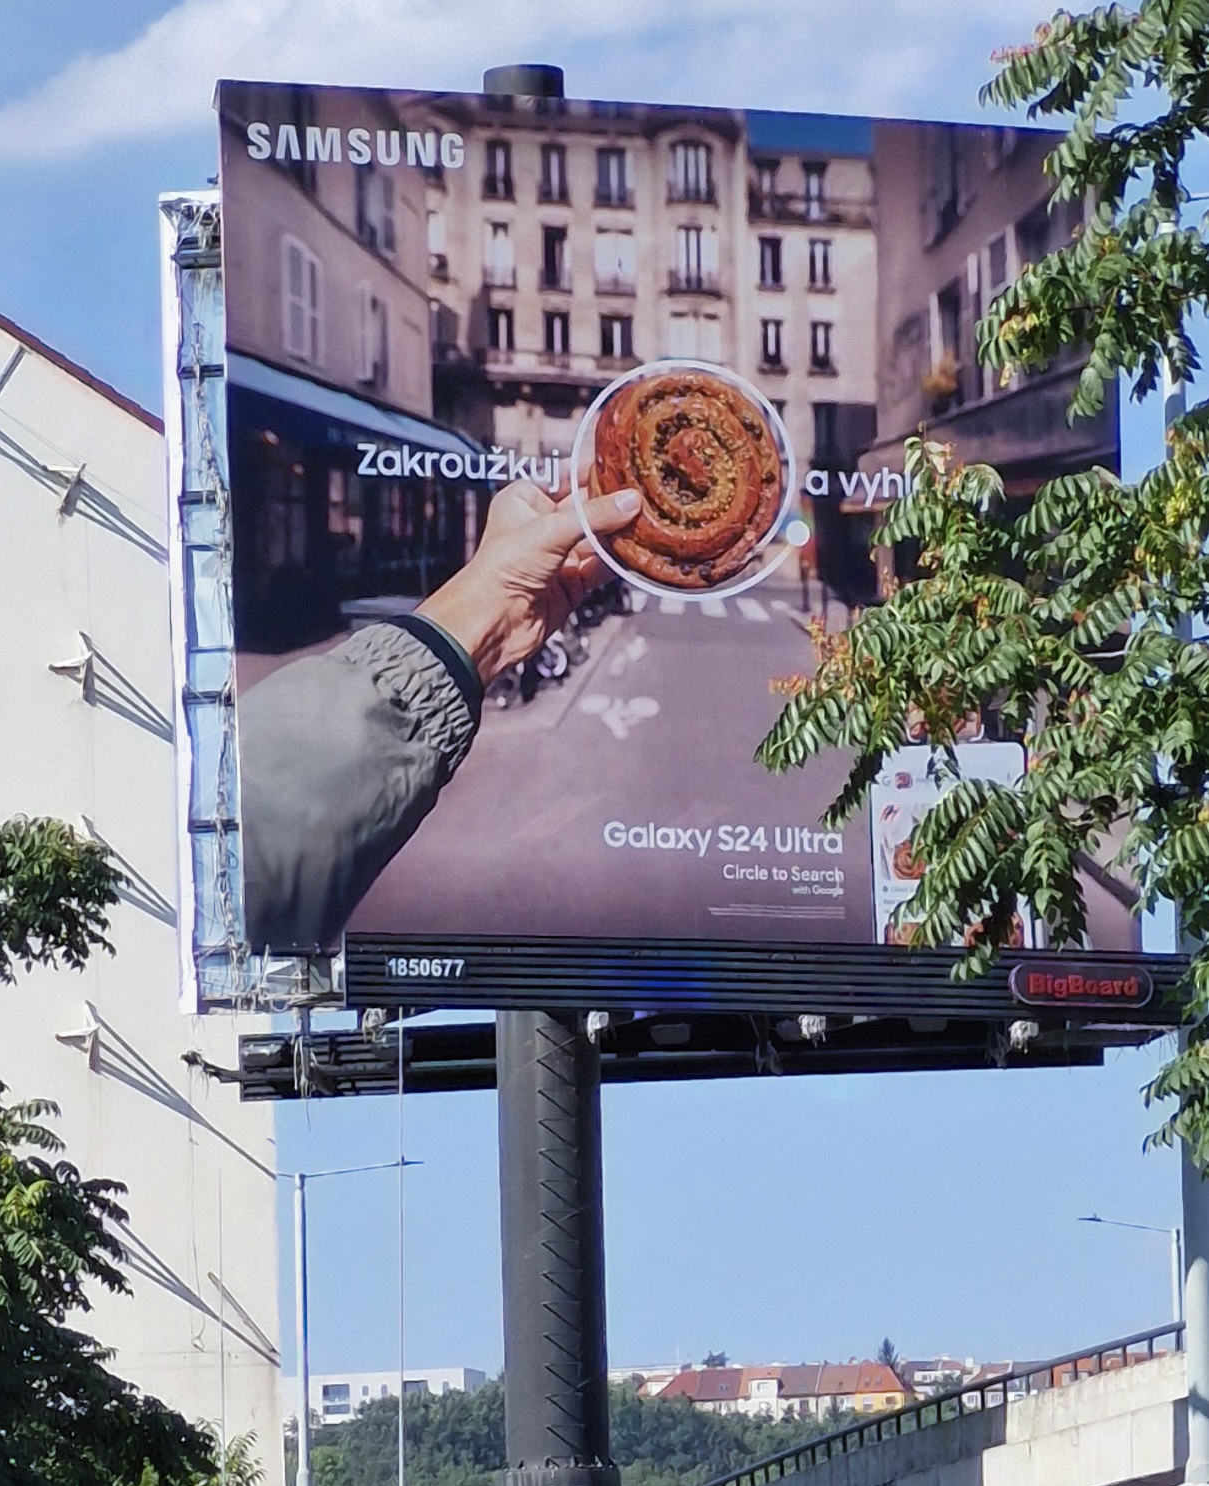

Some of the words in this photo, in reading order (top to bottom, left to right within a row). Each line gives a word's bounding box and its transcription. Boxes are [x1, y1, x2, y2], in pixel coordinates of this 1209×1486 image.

[246, 121, 465, 169] SAMSUNG
[356, 442, 561, 494] Zakroužkuj
[805, 469, 829, 496] a
[602, 820, 713, 857] Galaxy
[717, 824, 769, 852] S24
[774, 826, 844, 854] Ultra
[722, 863, 769, 881] Circle
[771, 866, 789, 882] to
[790, 866, 845, 883] Search
[387, 957, 465, 977] 1850677
[1028, 972, 1139, 998] BigBoard
